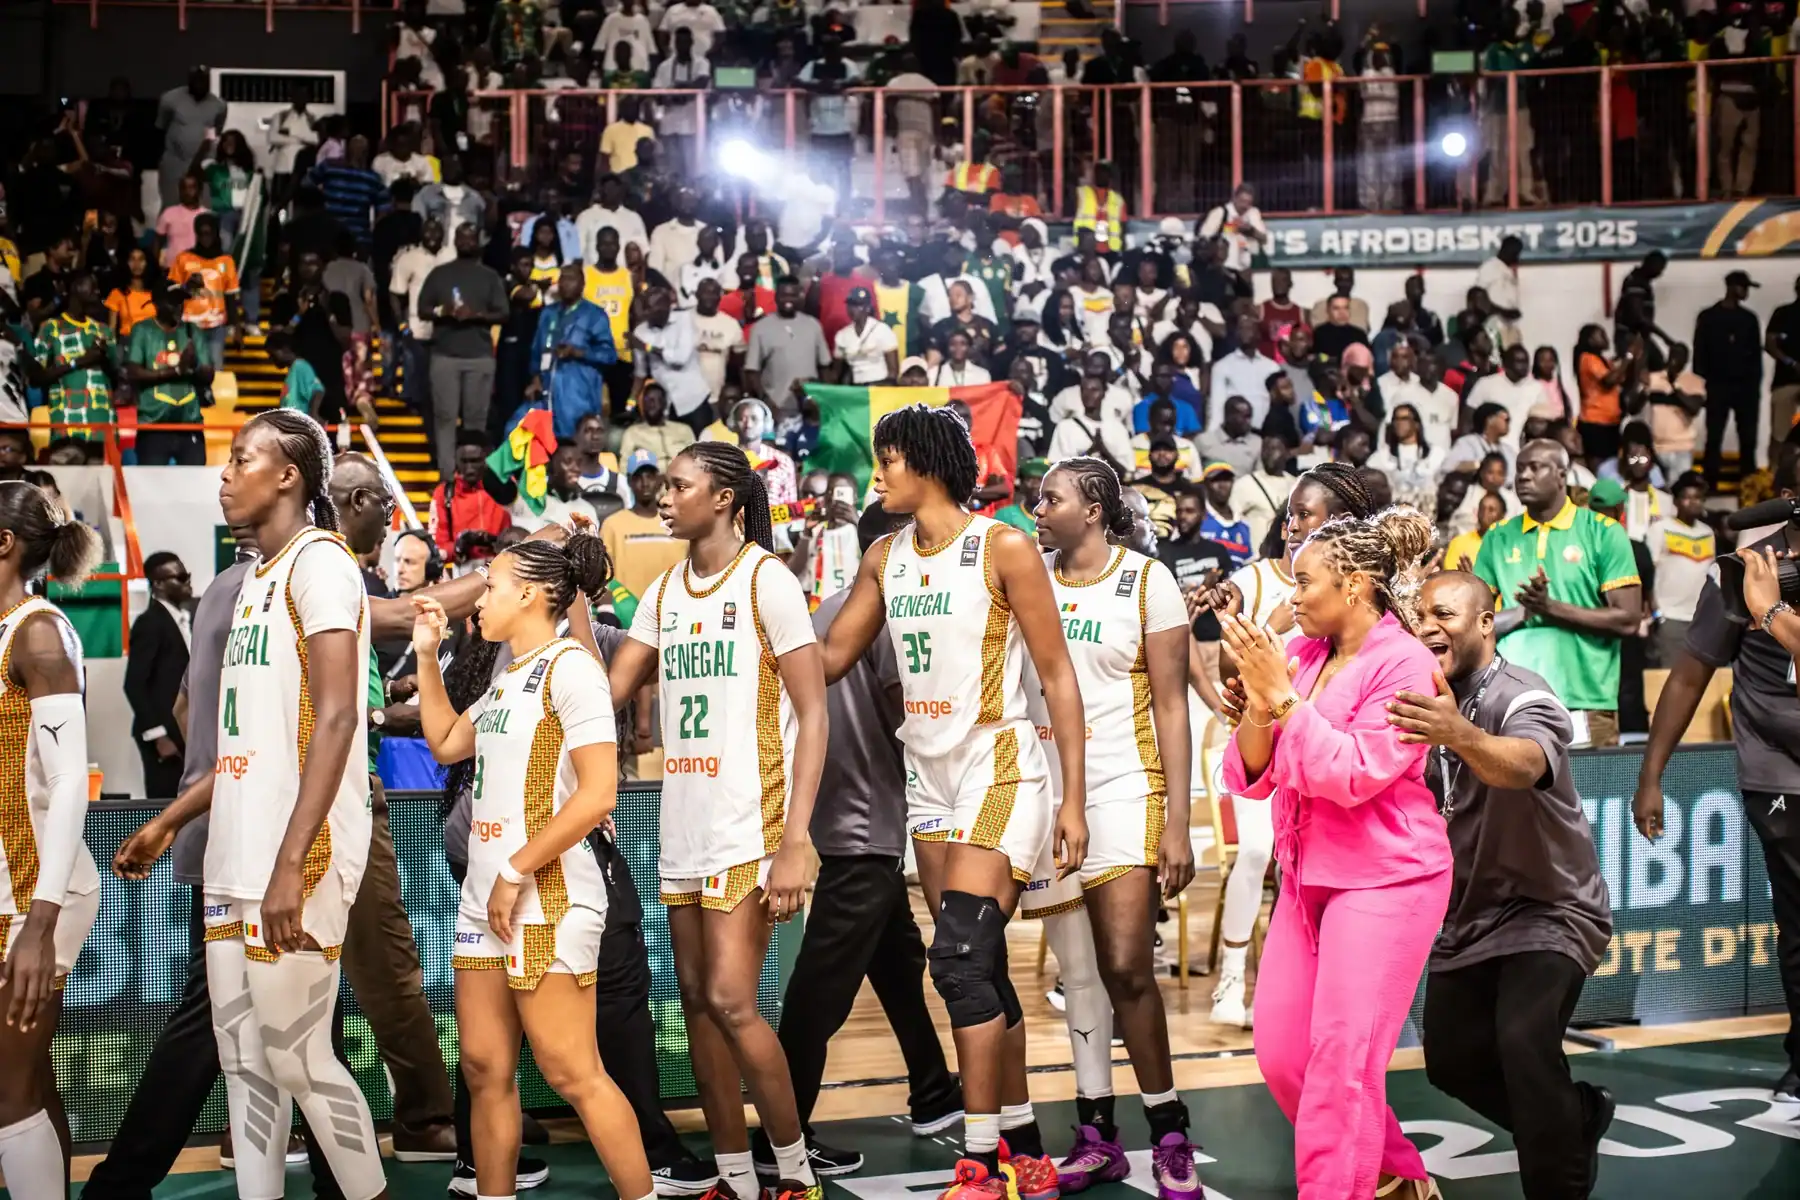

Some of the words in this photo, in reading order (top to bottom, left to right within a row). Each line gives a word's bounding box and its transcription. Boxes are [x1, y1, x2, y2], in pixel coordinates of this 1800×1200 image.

[1556, 220, 1638, 247] 2025
[889, 591, 952, 619] SENEGAL
[664, 640, 738, 681] SENEGAL
[902, 632, 932, 674] 35
[224, 687, 239, 736] 4
[680, 694, 709, 739] 22
[905, 700, 952, 719] ange
[665, 756, 721, 778] orang
[471, 820, 503, 842] ange
[1593, 929, 1681, 977] OTE
